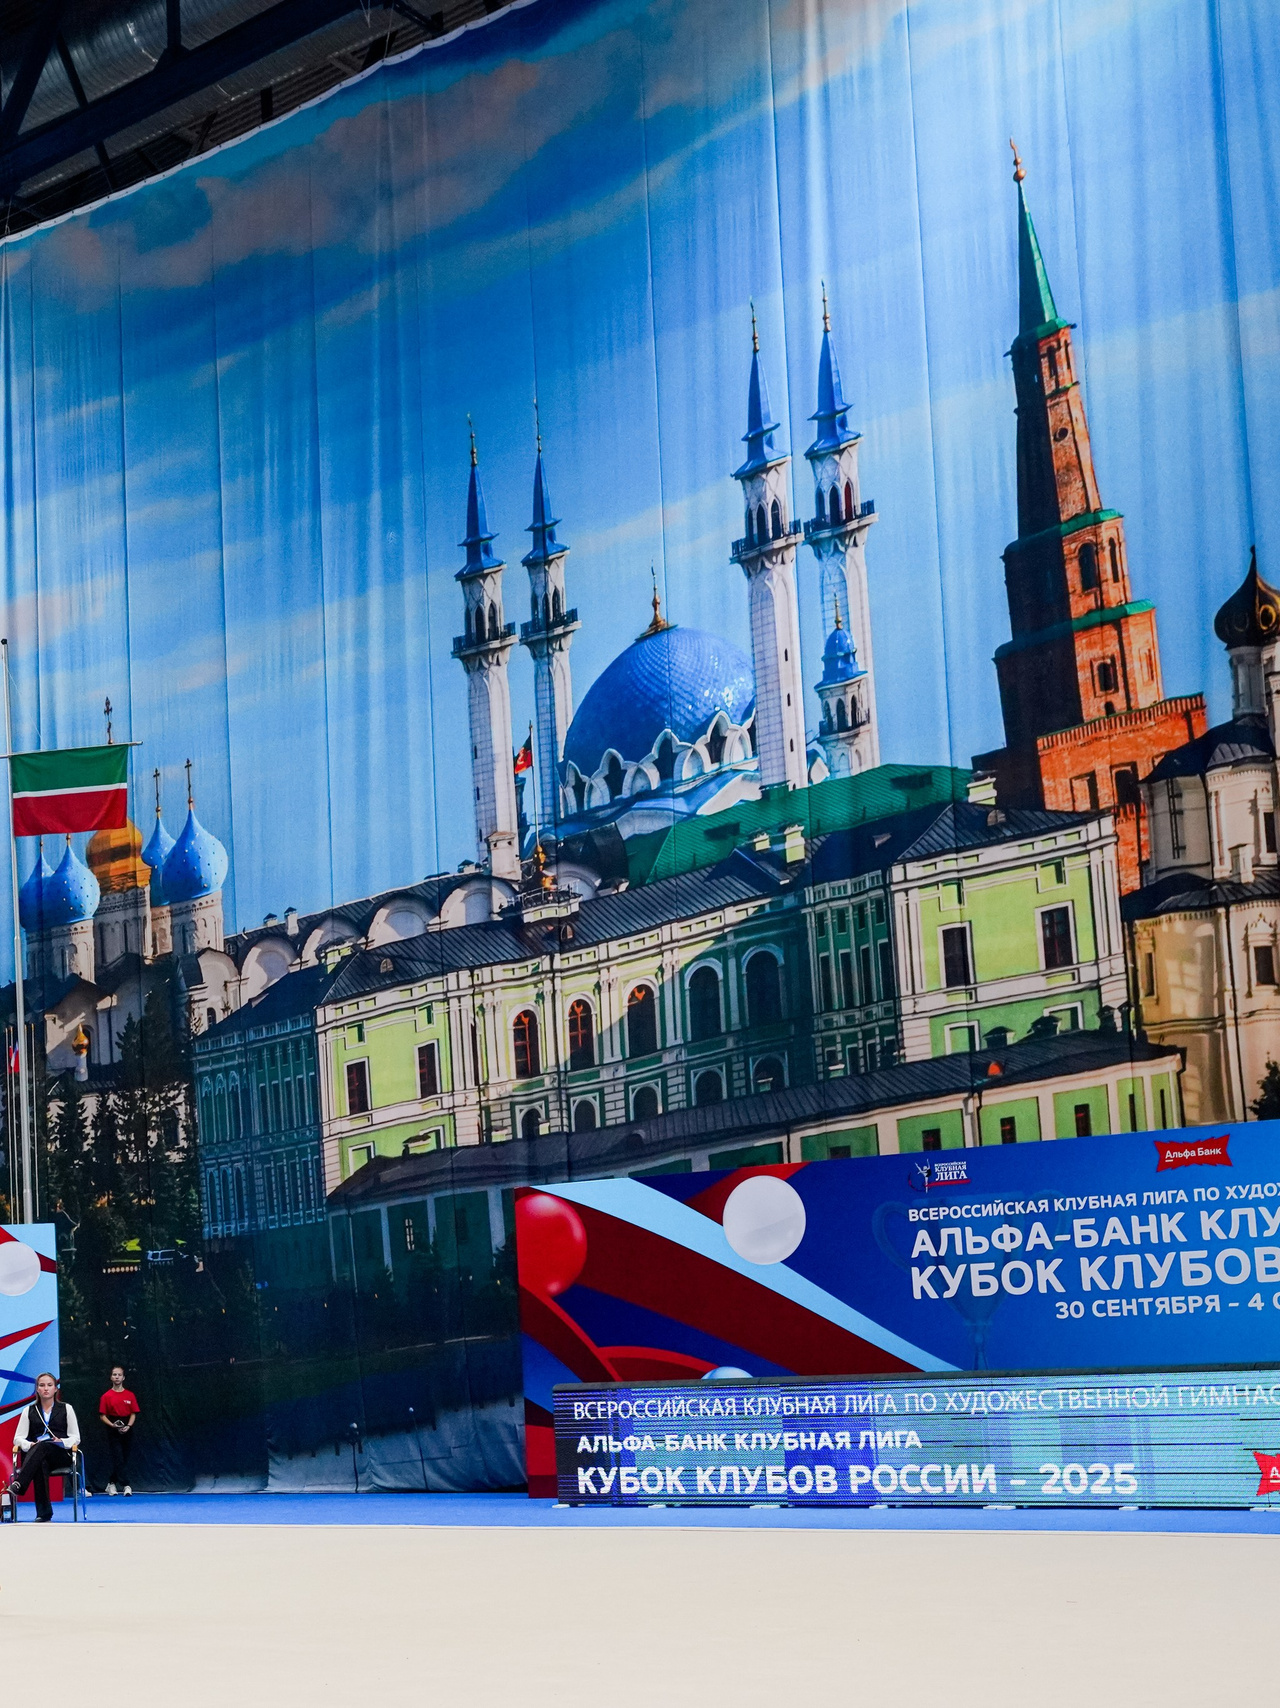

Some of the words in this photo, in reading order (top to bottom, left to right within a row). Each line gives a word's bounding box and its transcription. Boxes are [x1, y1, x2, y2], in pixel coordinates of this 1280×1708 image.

[1165, 1149, 1196, 1158] Альфа
[1197, 1147, 1222, 1156] Банк
[935, 1170, 968, 1181] ЛИГА
[908, 1199, 1049, 1222] ВСЕРОССИЙСКАЯ
[1053, 1193, 1137, 1212] КЛУБНАЯ
[1142, 1189, 1188, 1206] ЛИГА
[1193, 1187, 1220, 1202] ПО
[1225, 1182, 1280, 1200] ХУДО
[911, 1211, 1187, 1258] АЛЬФА-БАНК
[911, 1258, 1066, 1300] КУБОК
[1080, 1246, 1280, 1292] КЛУБОВ
[1055, 1301, 1085, 1320] 30
[1091, 1294, 1220, 1318] СЕНТЯБРЯ
[1247, 1292, 1265, 1311] 4
[573, 1396, 737, 1420] ВСЕРОССИЙСКАЯ
[743, 1395, 837, 1415] КЛУБНАЯ
[844, 1393, 898, 1413] ЛИГА
[904, 1392, 938, 1412] ПО
[944, 1384, 1169, 1415] ХУДОЖЕСТВЕННОЙ
[577, 1433, 728, 1453] АЛЬФА-БАНК
[734, 1431, 851, 1451] КЛУБНАЯ
[858, 1430, 923, 1450] ЛИГА
[577, 1466, 686, 1494] КУБОК
[696, 1465, 839, 1494] КЛУБОВ
[849, 1464, 997, 1494] РОССИИ
[1039, 1463, 1138, 1494] 2025
